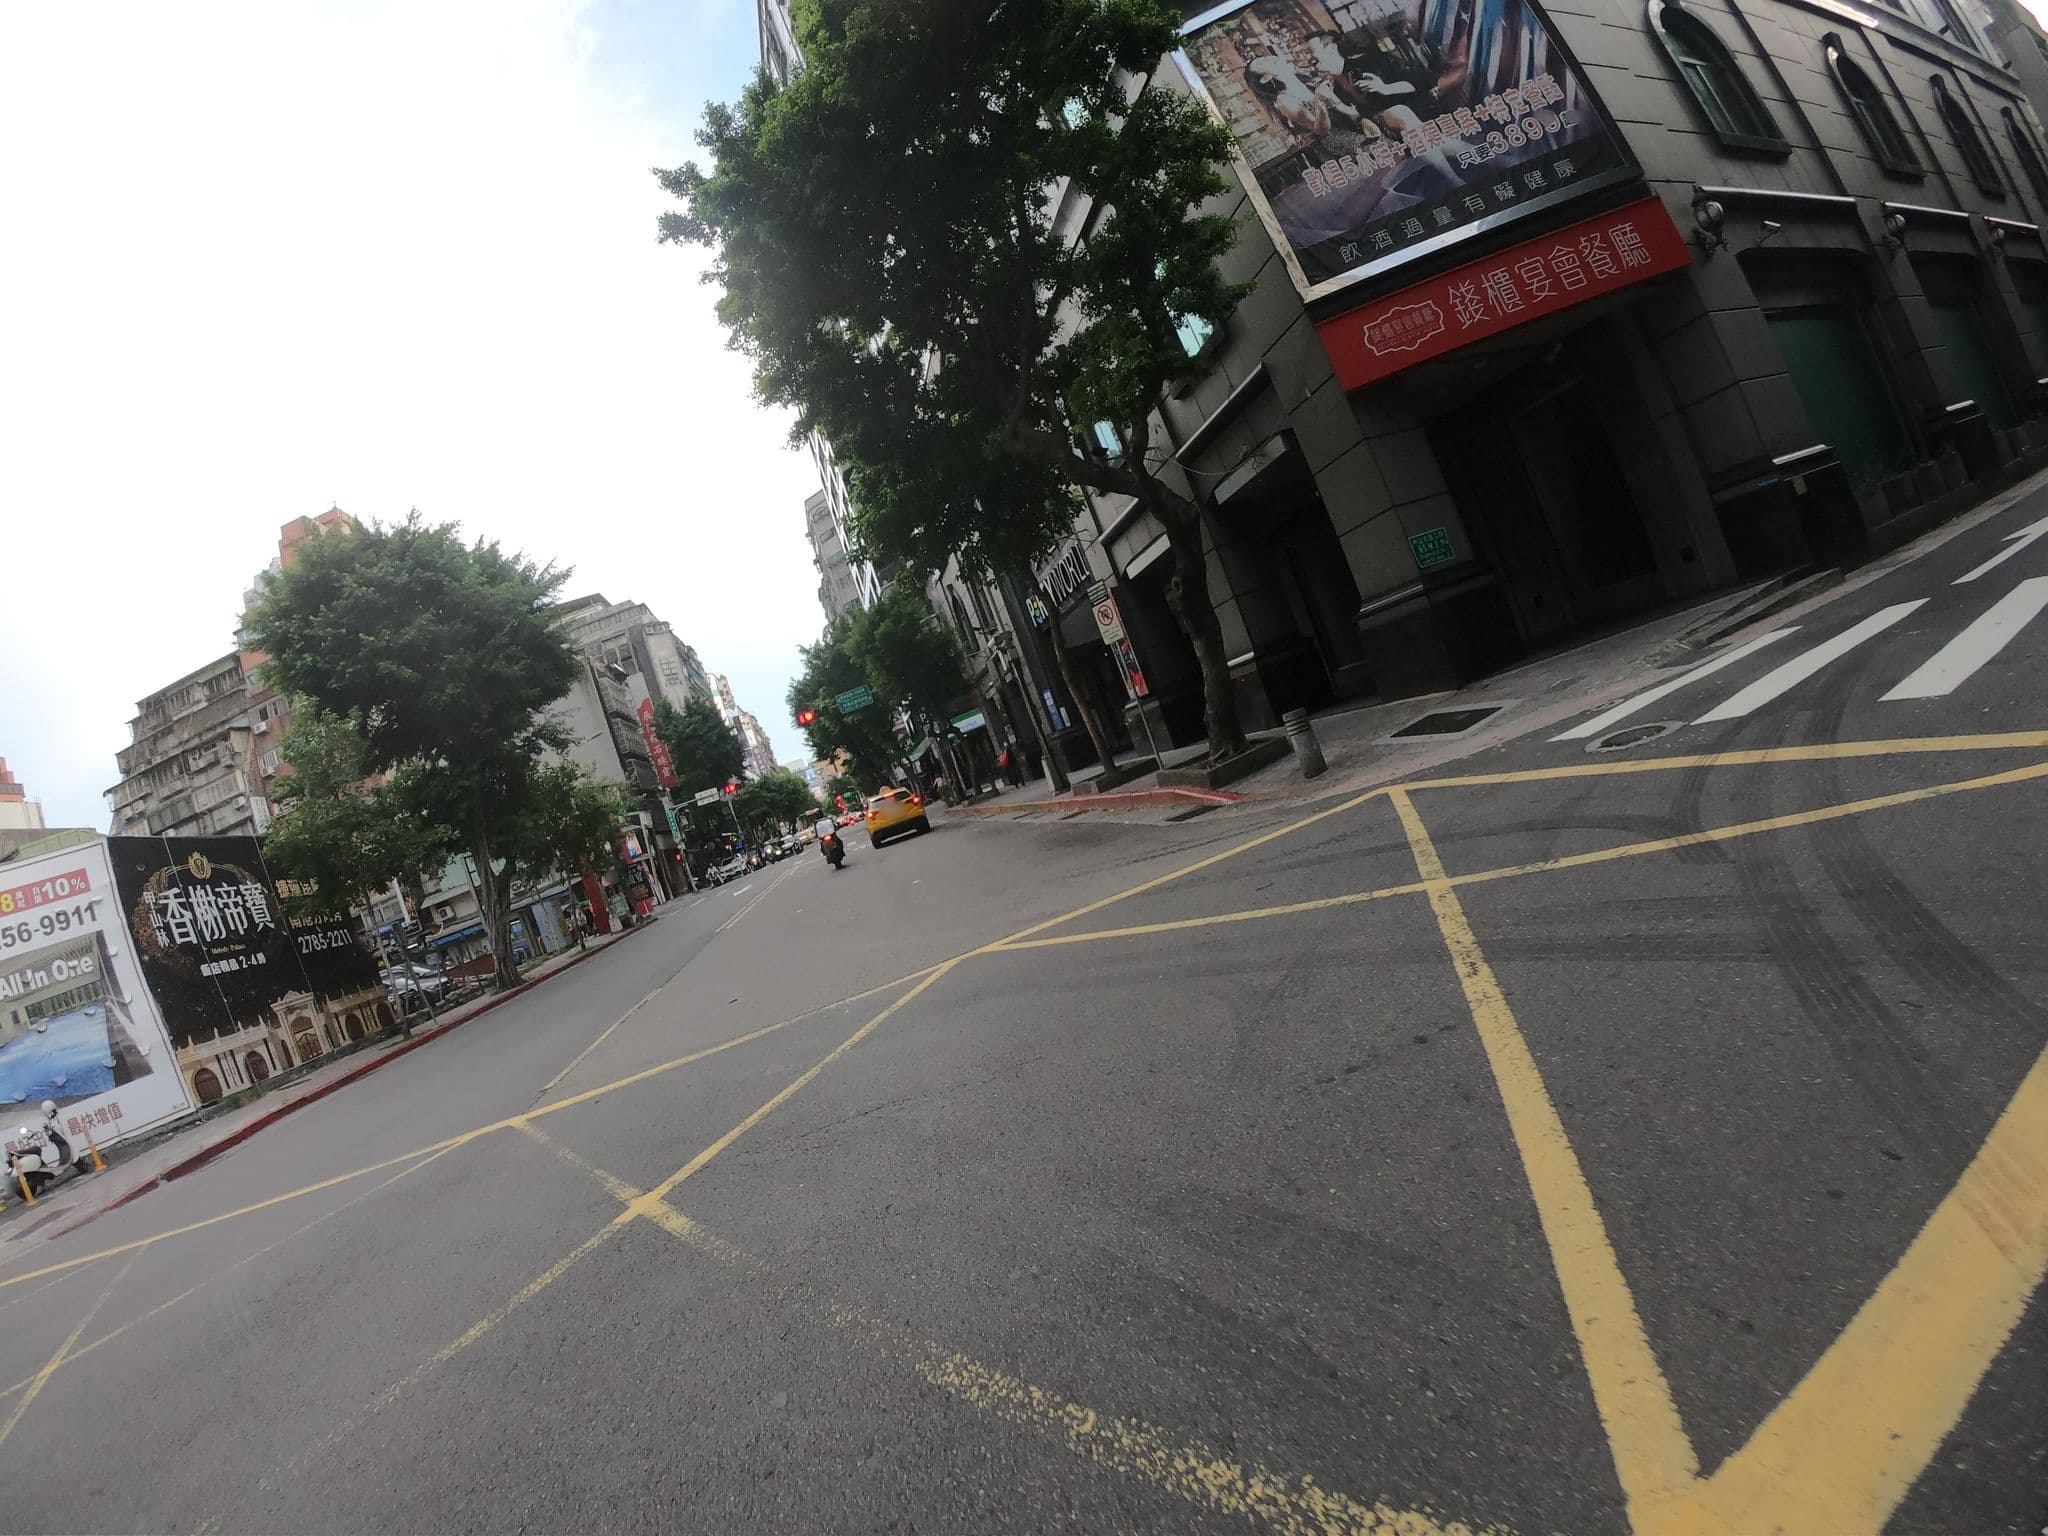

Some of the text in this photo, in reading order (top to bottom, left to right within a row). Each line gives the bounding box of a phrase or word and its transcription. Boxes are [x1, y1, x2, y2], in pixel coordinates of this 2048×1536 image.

[1338, 158, 1577, 264] 飲酒過量有礙健康
[1448, 222, 1651, 329] 錢櫃宴會餐廳
[0, 892, 15, 913] 8
[42, 876, 86, 900] 10%
[158, 881, 275, 945] 香榭帝寶
[0, 901, 97, 951] 56-9911
[297, 928, 353, 954] 2785-2211
[0, 972, 25, 1001] All
[51, 955, 95, 982] One
[67, 1102, 124, 1136] 最快增值
